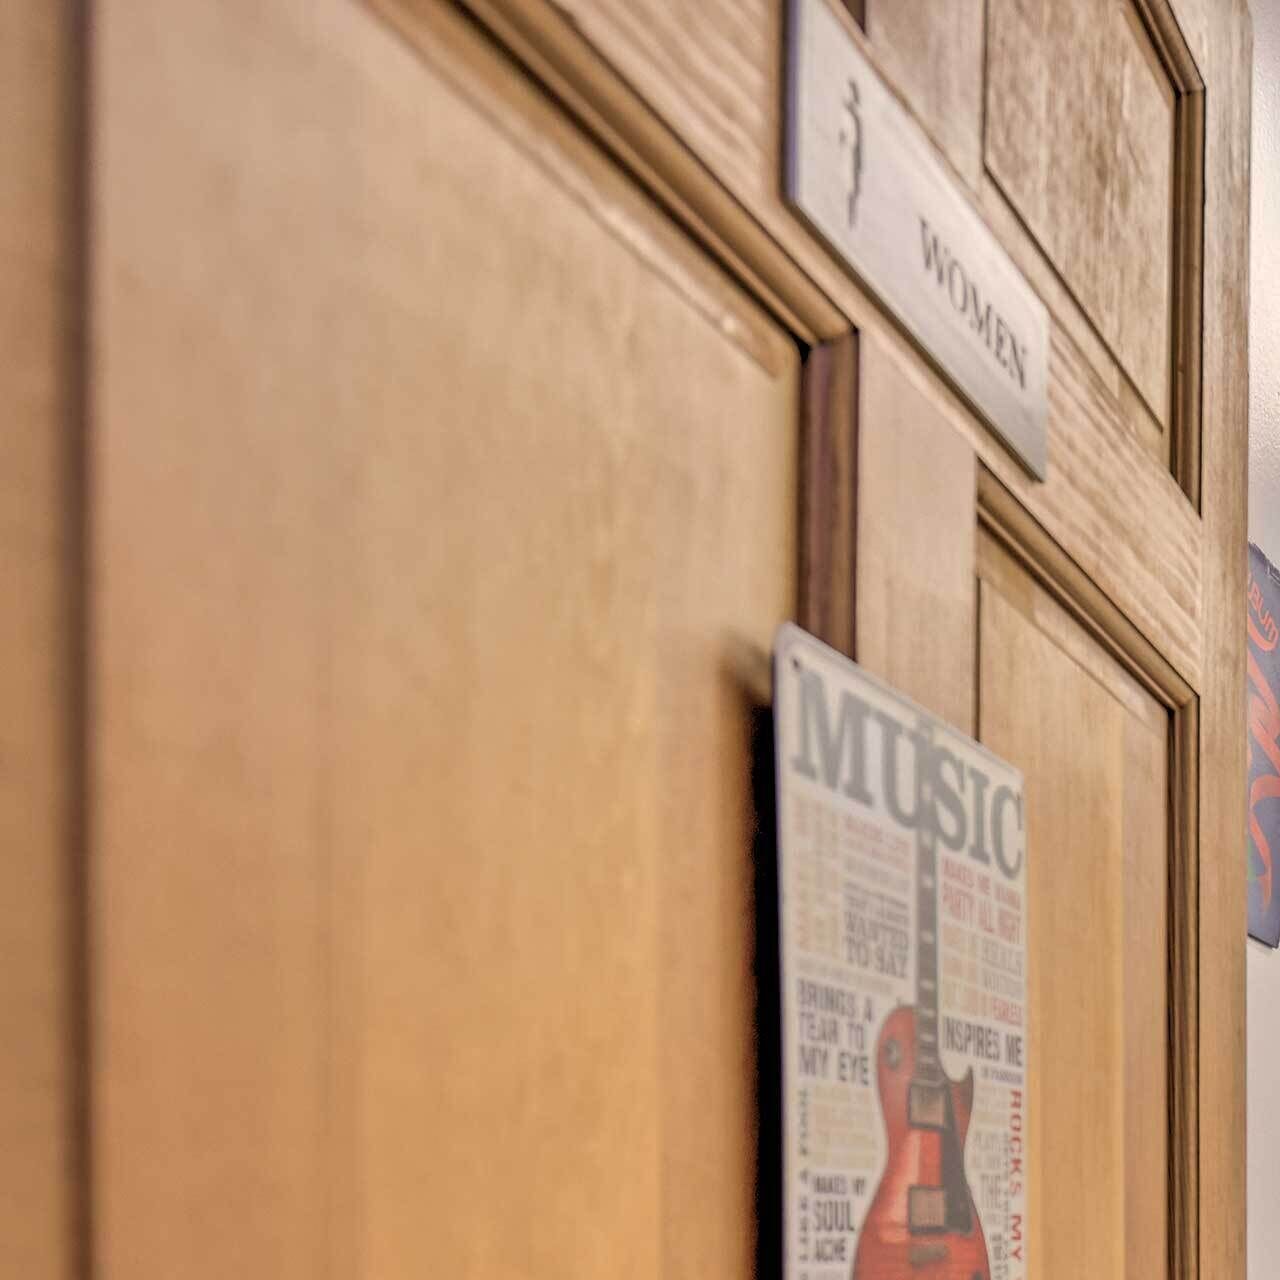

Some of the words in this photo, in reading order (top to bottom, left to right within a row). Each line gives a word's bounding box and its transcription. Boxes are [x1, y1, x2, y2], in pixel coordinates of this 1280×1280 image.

[919, 216, 1028, 391] WOMEN
[790, 671, 1023, 880] MUSIC
[798, 979, 855, 1018] BRINGS
[864, 996, 874, 1022] A
[799, 1011, 839, 1044] TEAR
[847, 1022, 867, 1050] TO
[942, 1016, 1000, 1061] INSPIRES
[1005, 1033, 1023, 1068] ME
[799, 1044, 829, 1078] MY
[838, 1050, 869, 1086] EYE
[1008, 1088, 1023, 1198] ROCKS
[813, 1200, 854, 1233] SOUL
[1008, 1213, 1023, 1263] MY
[814, 1238, 846, 1263] ACHE
